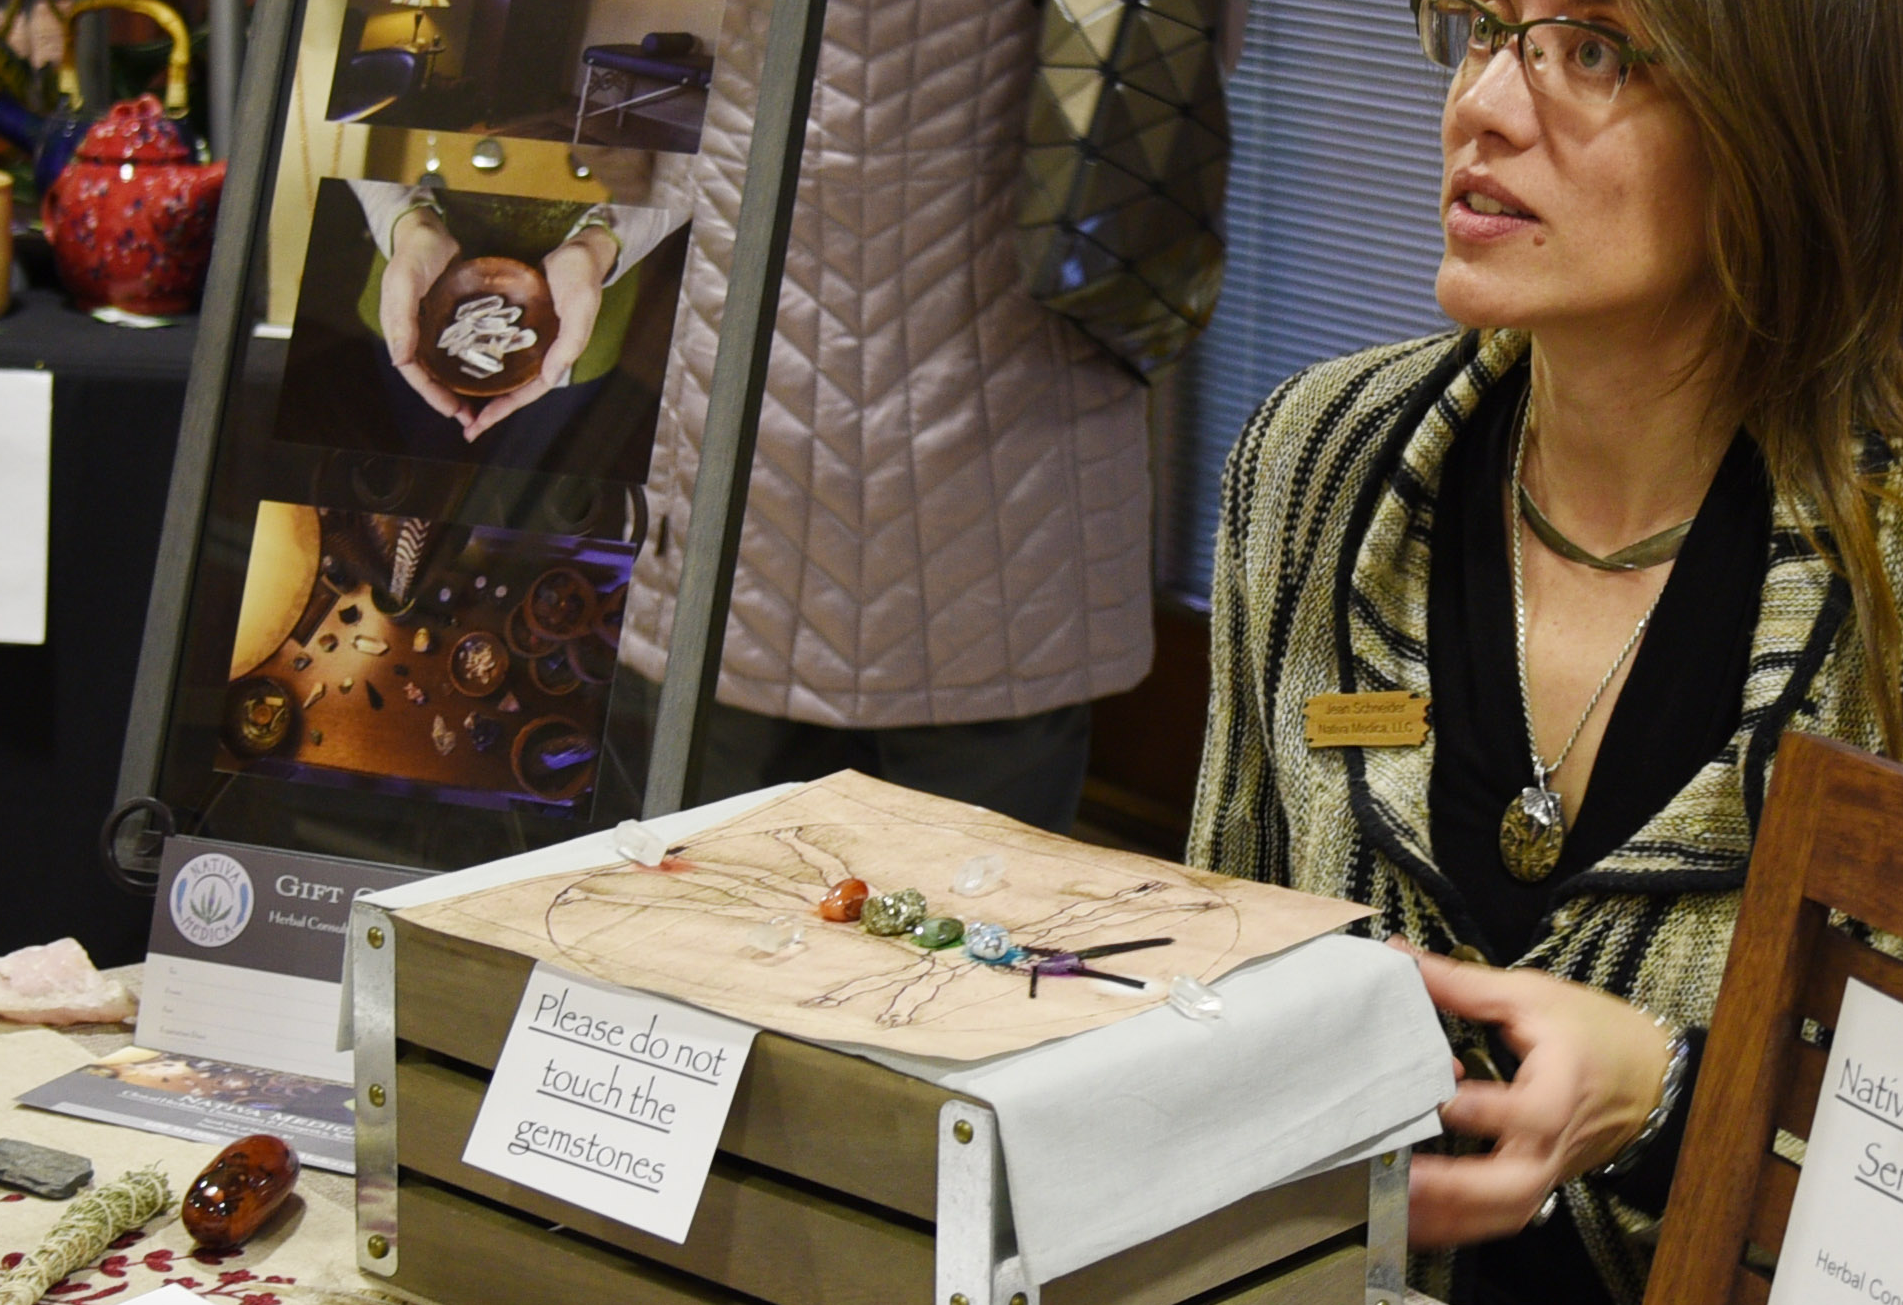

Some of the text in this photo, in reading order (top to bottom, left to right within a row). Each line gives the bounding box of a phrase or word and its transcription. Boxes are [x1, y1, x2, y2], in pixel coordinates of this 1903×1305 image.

[1327, 703, 1350, 714] Jean
[1318, 724, 1348, 734] Nativa
[1392, 722, 1413, 733] LLC
[189, 856, 242, 883] NATIVA
[181, 916, 236, 941] MEDICA
[268, 910, 307, 928] Herbal
[534, 988, 727, 1077] Please do not
[542, 1058, 676, 1125] touch the
[507, 1120, 666, 1184] gemstones
[1816, 1248, 1865, 1292] Herbal
